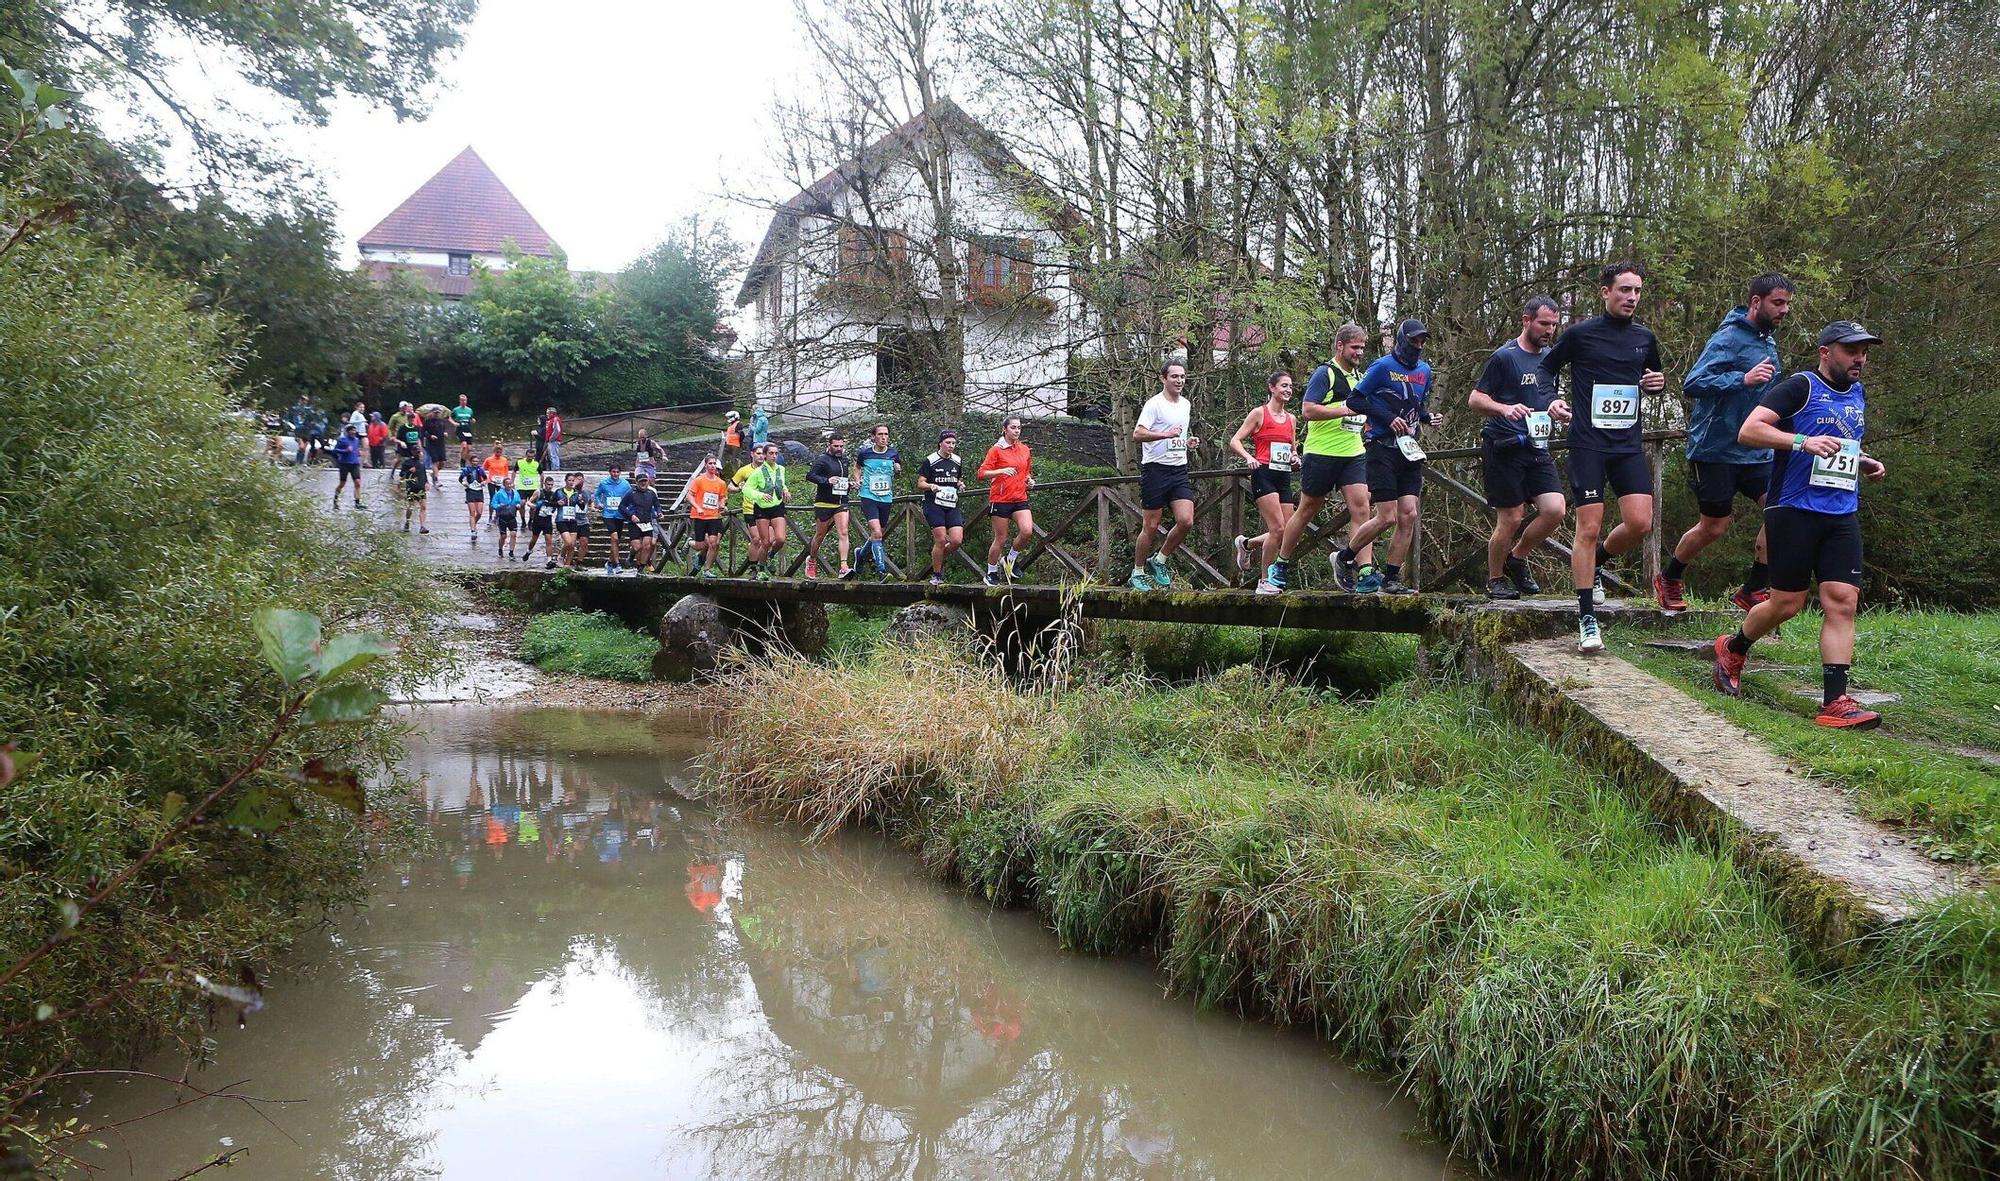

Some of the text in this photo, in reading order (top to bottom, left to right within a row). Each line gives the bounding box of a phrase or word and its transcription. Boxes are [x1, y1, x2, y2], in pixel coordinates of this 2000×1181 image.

[1602, 399, 1630, 413] 897
[1534, 424, 1549, 436] 948
[1826, 455, 1854, 472] 751
